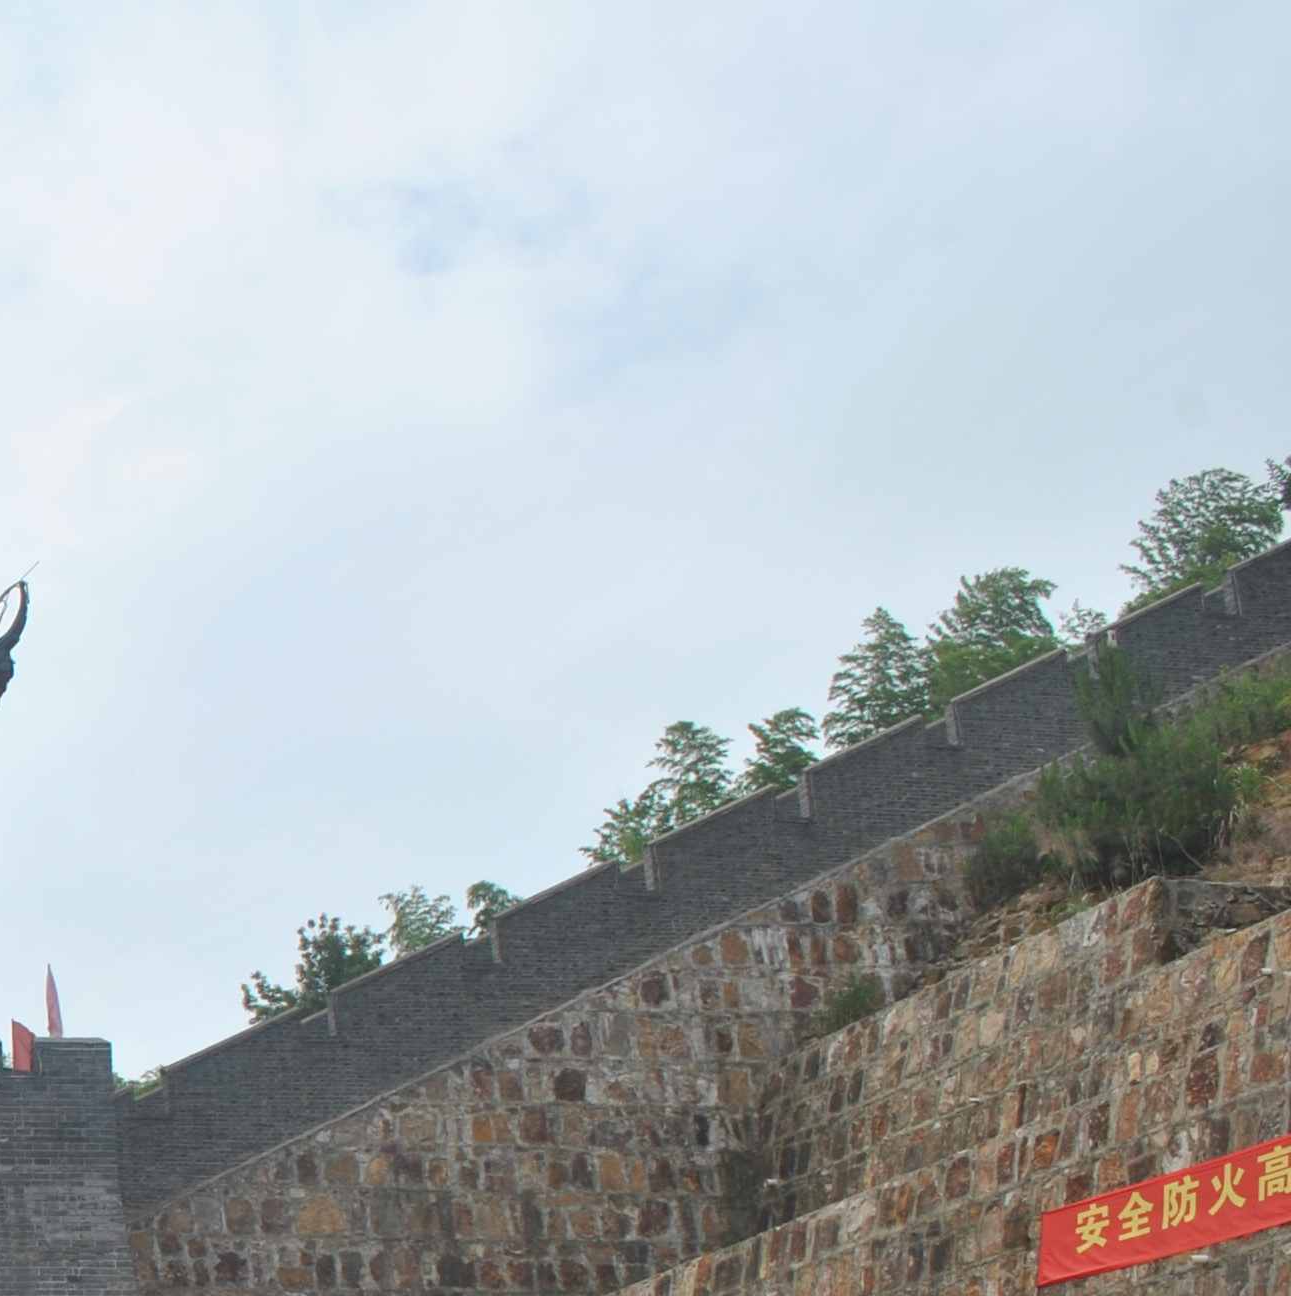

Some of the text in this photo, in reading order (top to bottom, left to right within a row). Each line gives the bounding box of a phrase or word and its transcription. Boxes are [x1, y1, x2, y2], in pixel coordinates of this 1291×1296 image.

[1074, 1144, 1291, 1255] 安全防火高
